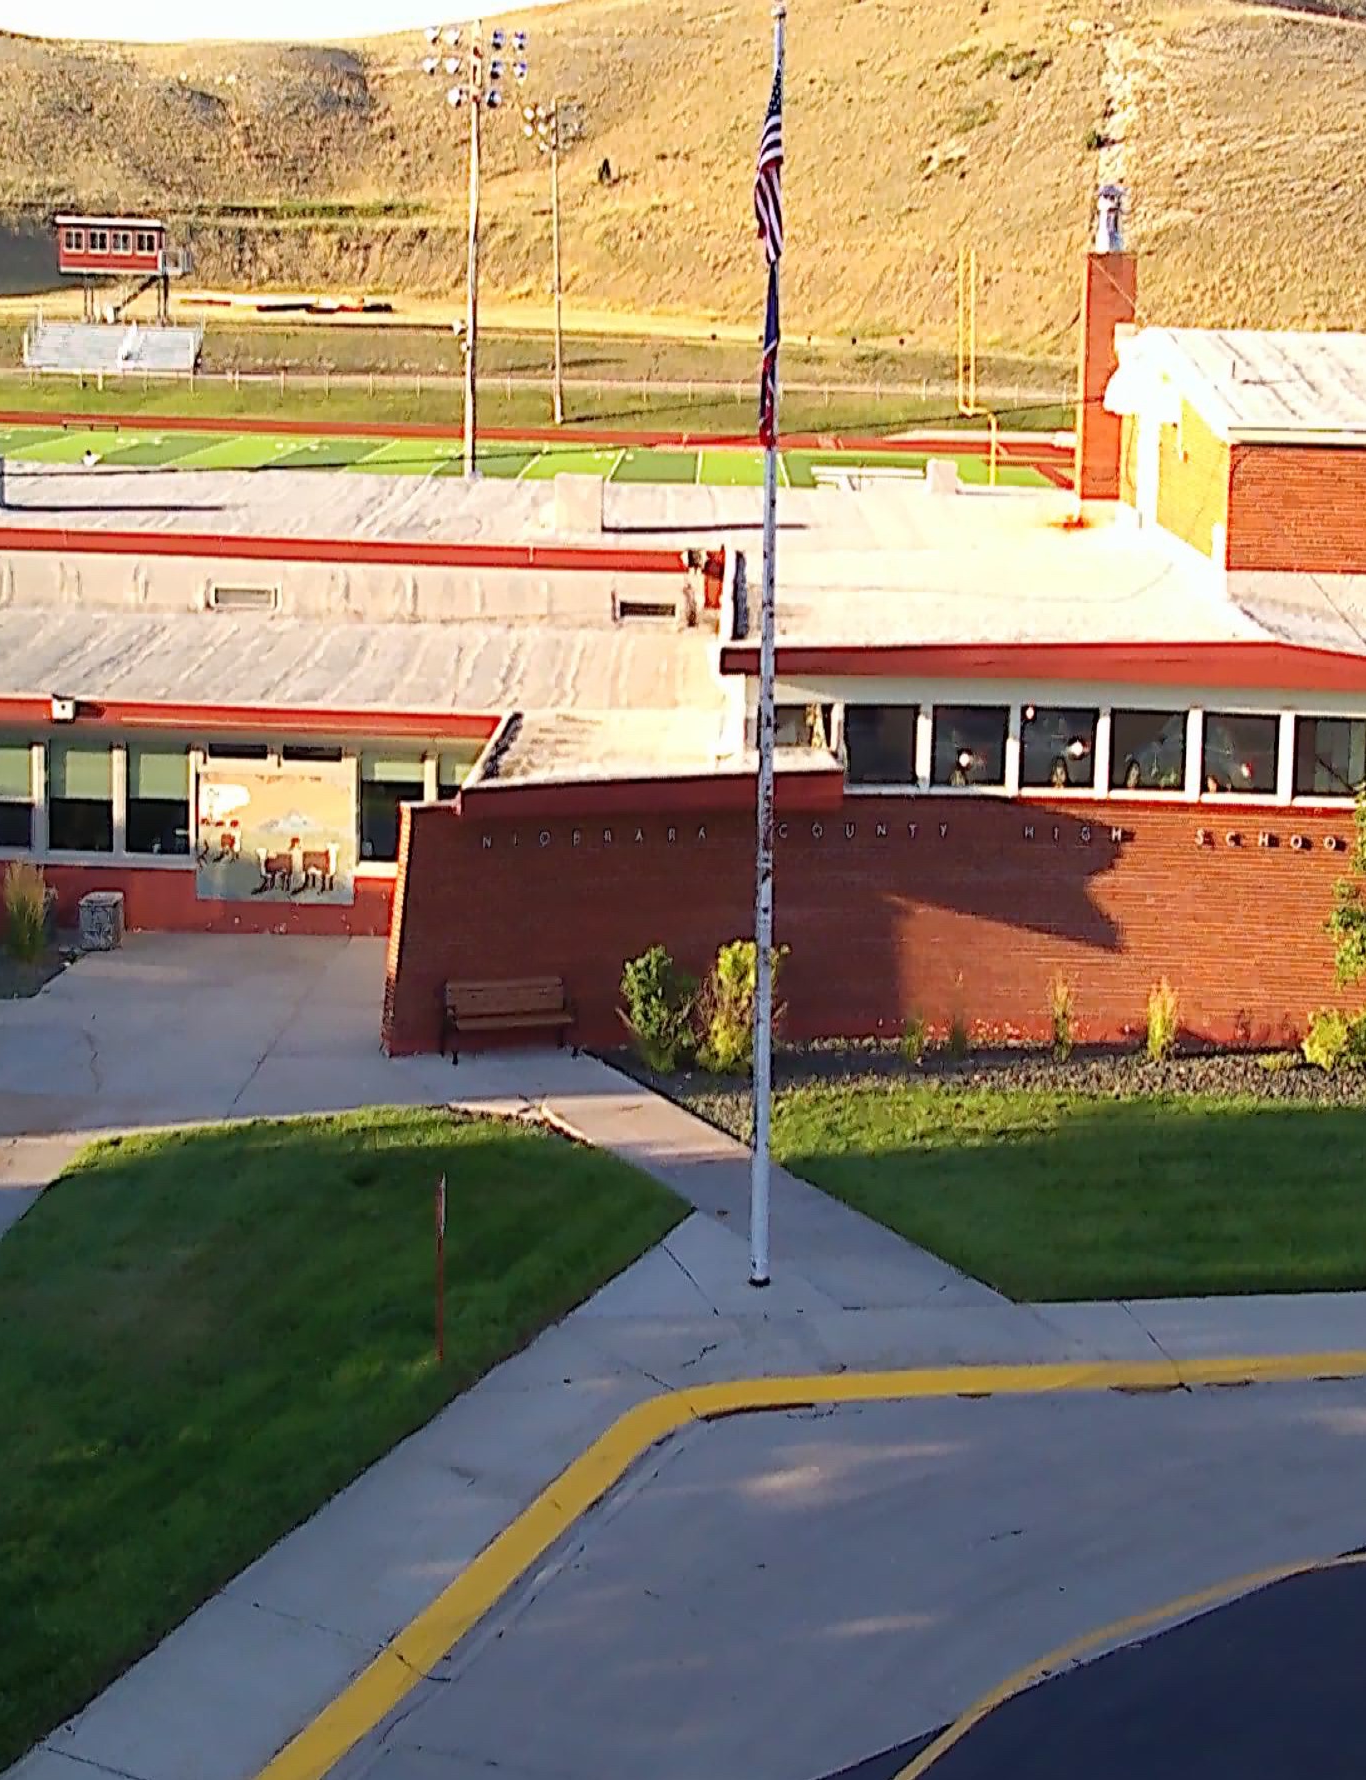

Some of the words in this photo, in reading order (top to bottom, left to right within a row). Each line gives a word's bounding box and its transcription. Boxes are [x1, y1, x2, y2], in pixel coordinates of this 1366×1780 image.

[482, 826, 707, 848] NIOBRARA
[778, 822, 948, 839] COUNTY
[1024, 826, 1122, 842] HIGH
[1195, 828, 1337, 850] SCHOO
